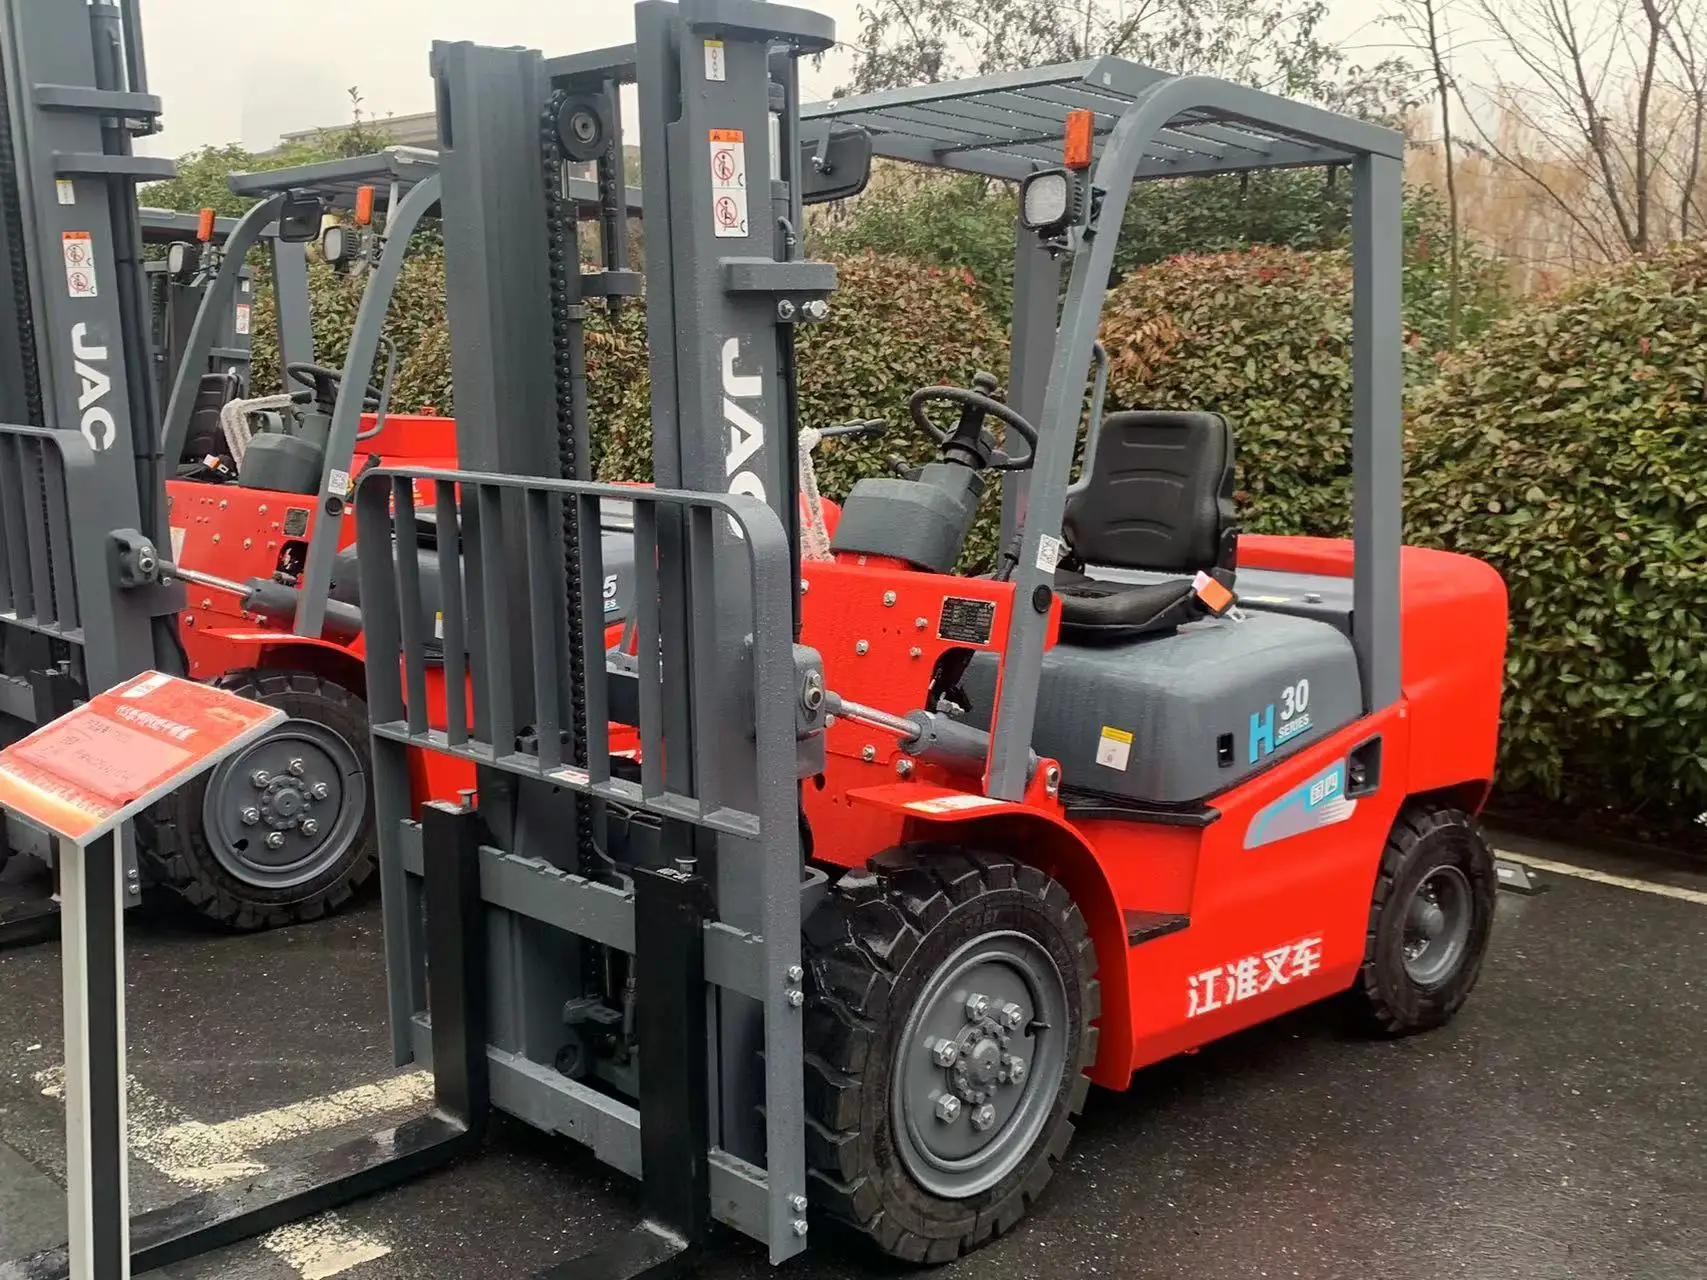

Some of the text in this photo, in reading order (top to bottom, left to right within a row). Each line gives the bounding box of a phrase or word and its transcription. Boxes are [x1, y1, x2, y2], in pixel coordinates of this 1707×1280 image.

[71, 322, 116, 452] JAC
[603, 574, 617, 598] 5
[1280, 679, 1309, 721] 30
[1249, 703, 1276, 764] H
[1278, 713, 1310, 739] SERIES
[1187, 937, 1323, 1018] 江淮叉车
